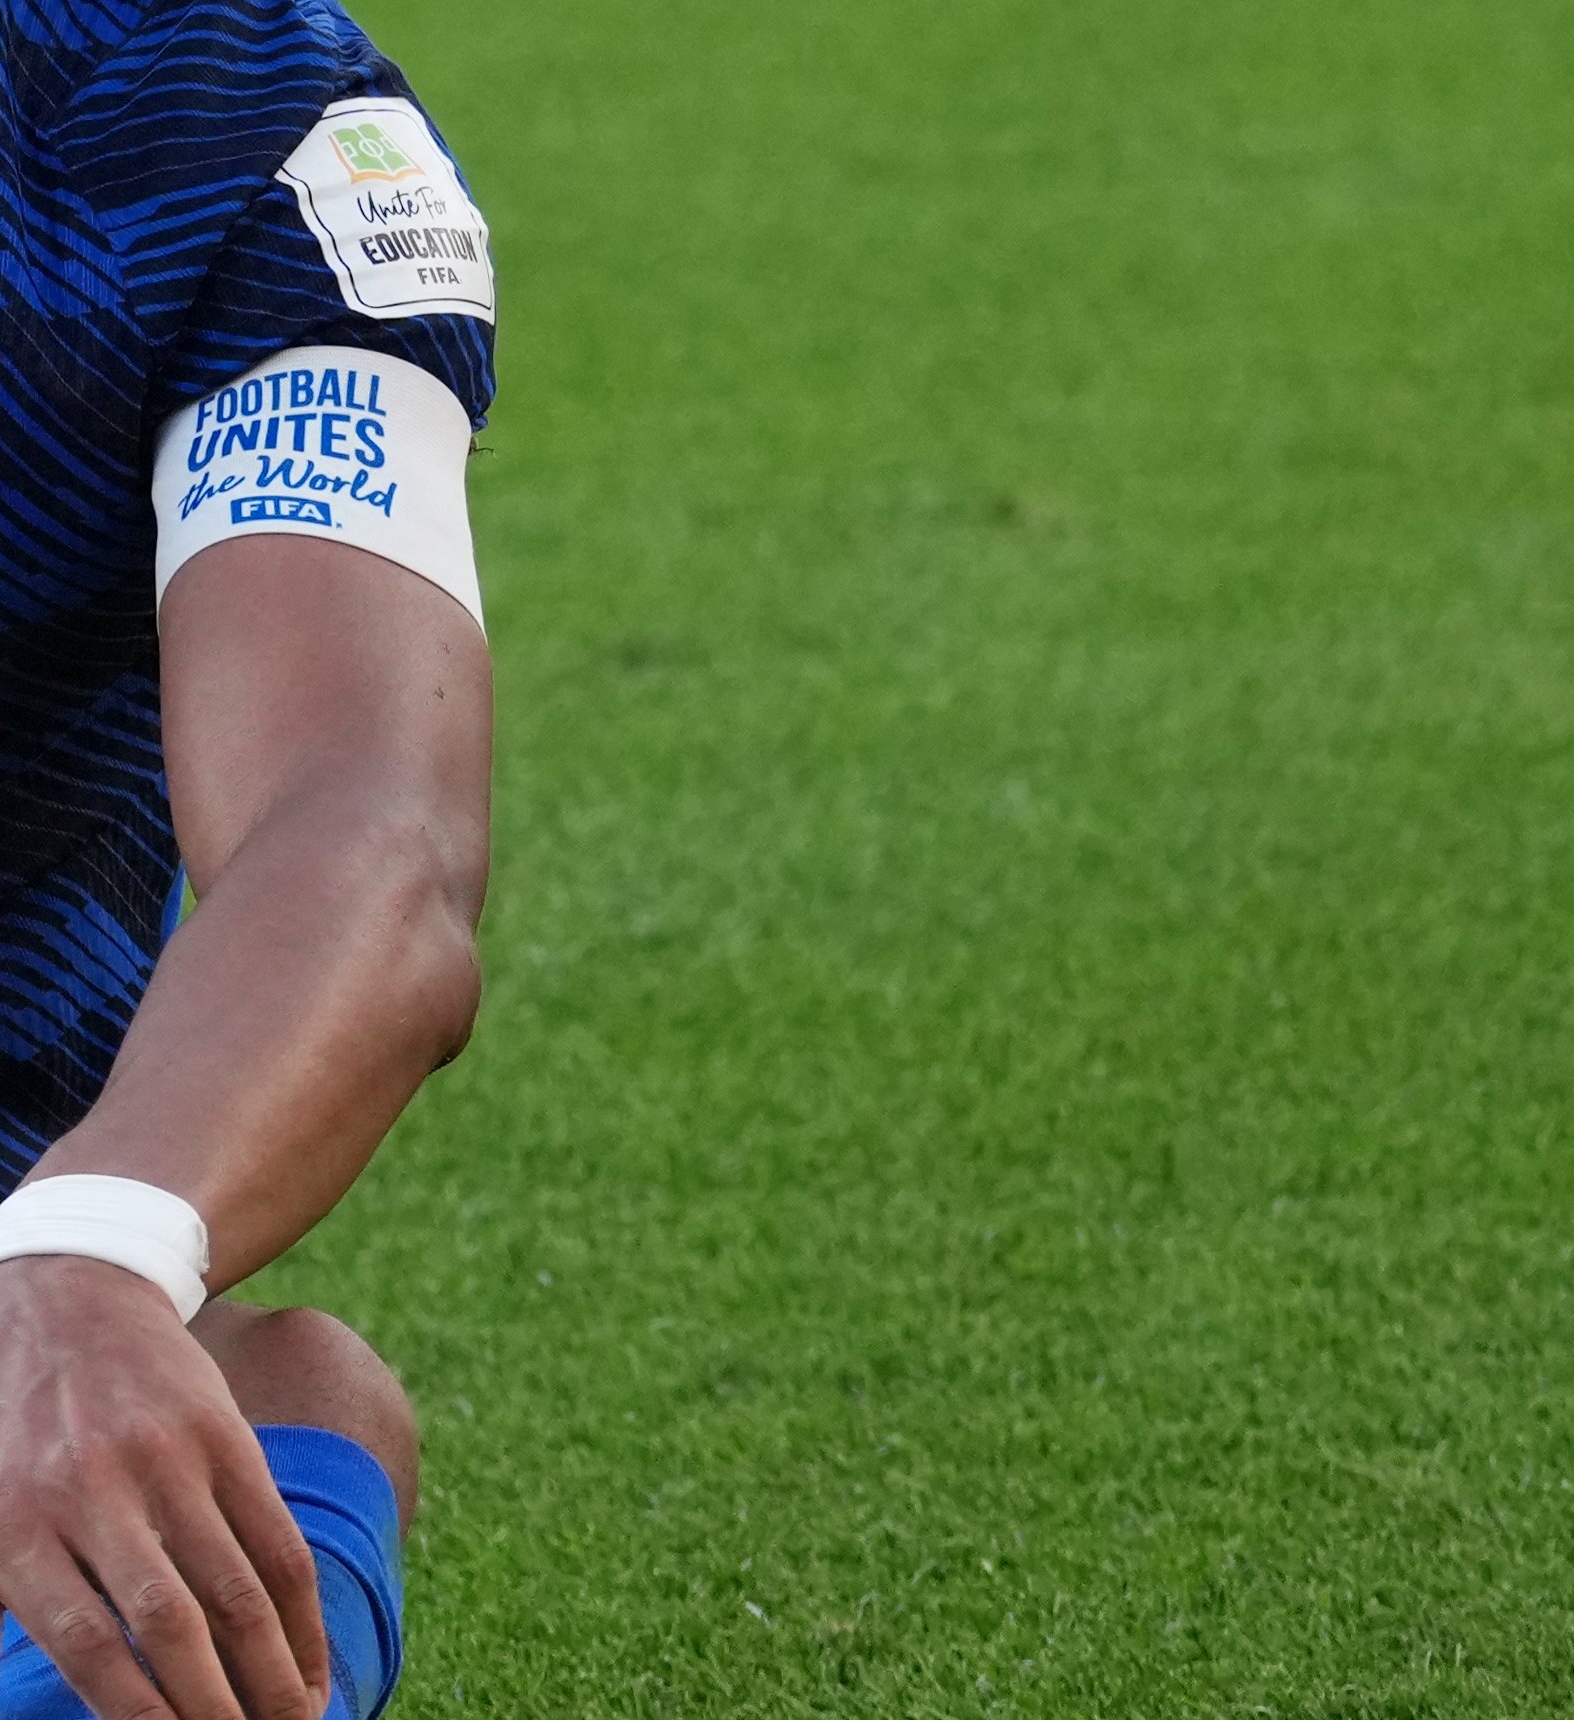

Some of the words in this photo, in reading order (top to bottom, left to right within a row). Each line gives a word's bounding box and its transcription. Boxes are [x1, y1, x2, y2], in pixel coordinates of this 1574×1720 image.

[357, 189, 419, 225] Unite
[415, 186, 447, 220] For
[359, 227, 478, 265] EDUCATION
[417, 267, 461, 285] FIFA
[196, 368, 387, 433] FOOTBALL
[187, 413, 385, 472] UNITES
[177, 471, 246, 521] the
[255, 454, 398, 519] World
[240, 499, 326, 521] FIFA
